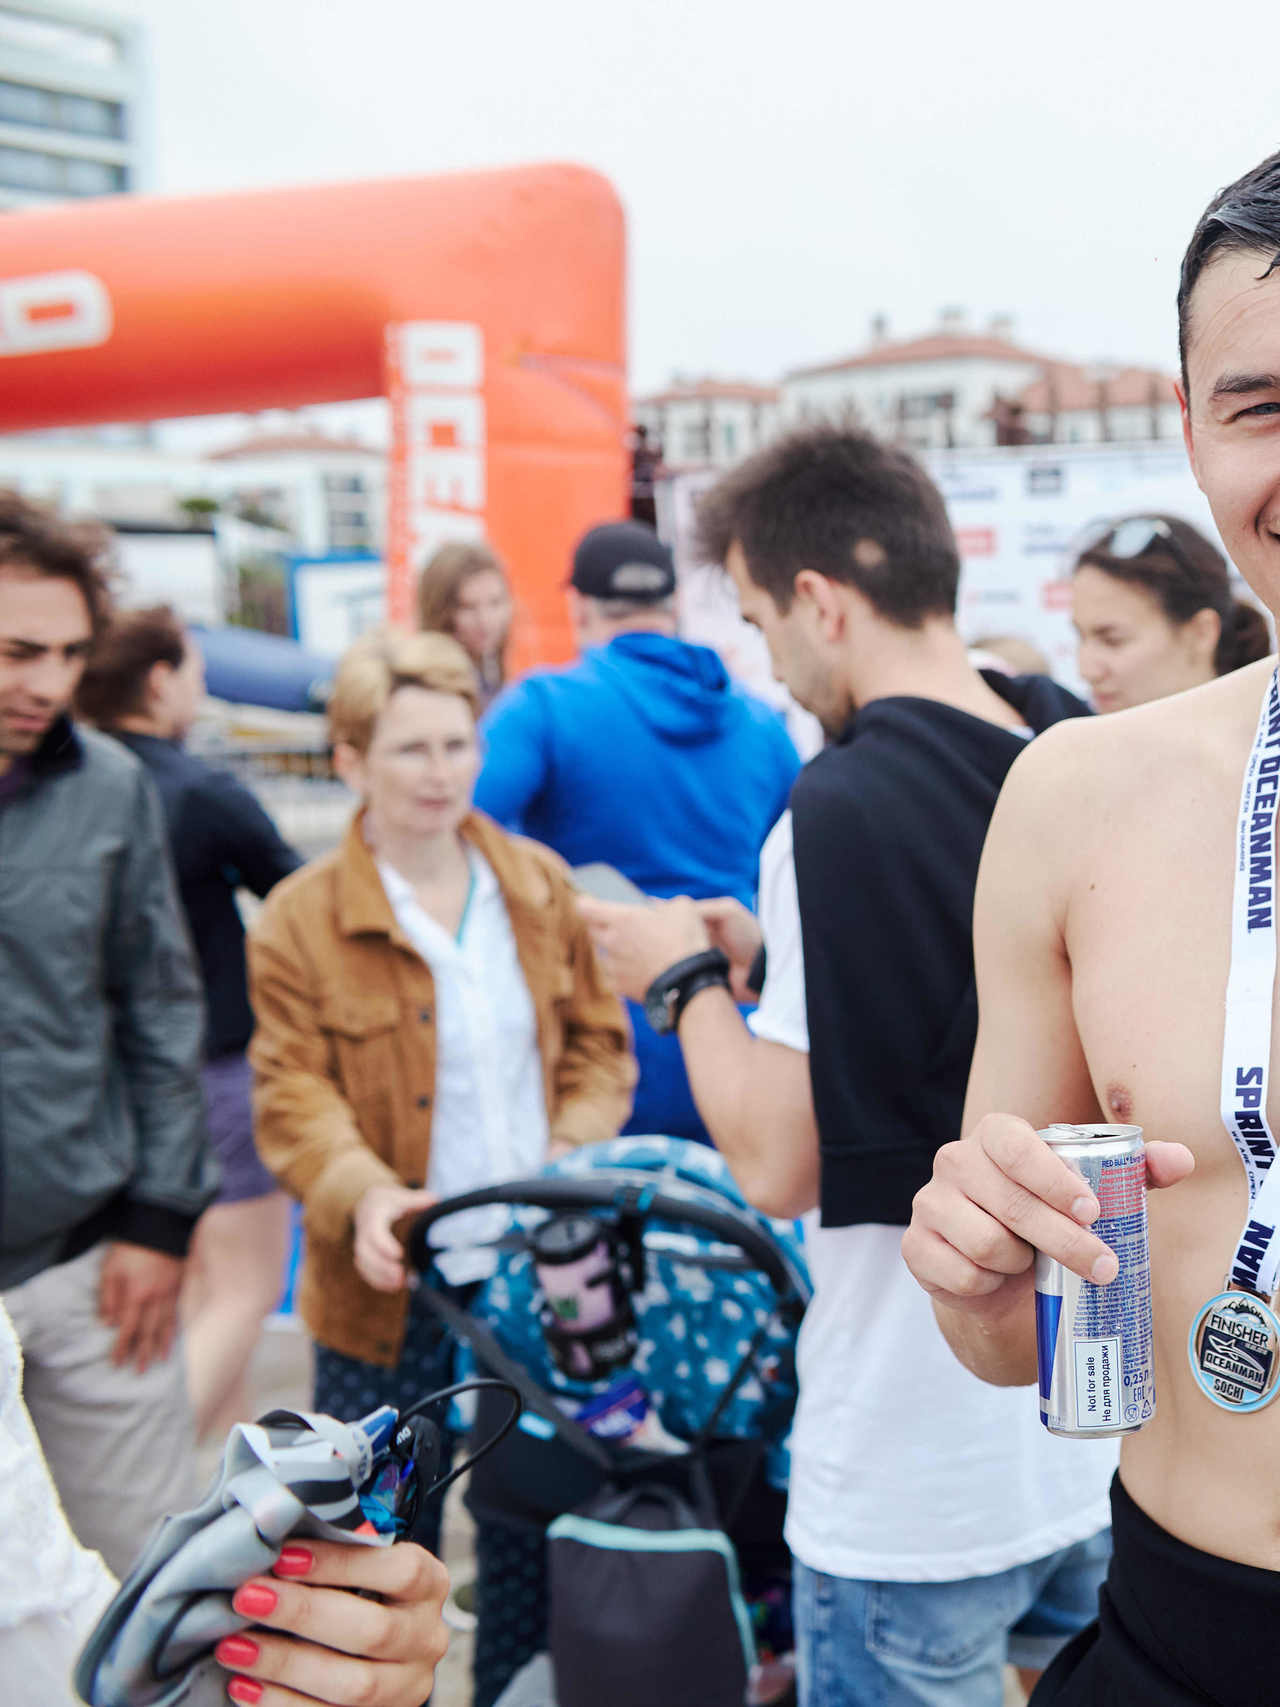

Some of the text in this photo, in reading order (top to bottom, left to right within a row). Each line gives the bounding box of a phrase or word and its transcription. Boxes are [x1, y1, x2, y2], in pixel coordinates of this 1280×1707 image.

[1210, 1314, 1269, 1347] FINISHER
[1086, 1356, 1097, 1412] Not for sale
[1102, 1344, 1112, 1422] Не для продажи
[1206, 1352, 1265, 1383] OCEANMAN
[1214, 1378, 1245, 1401] SOCHI
